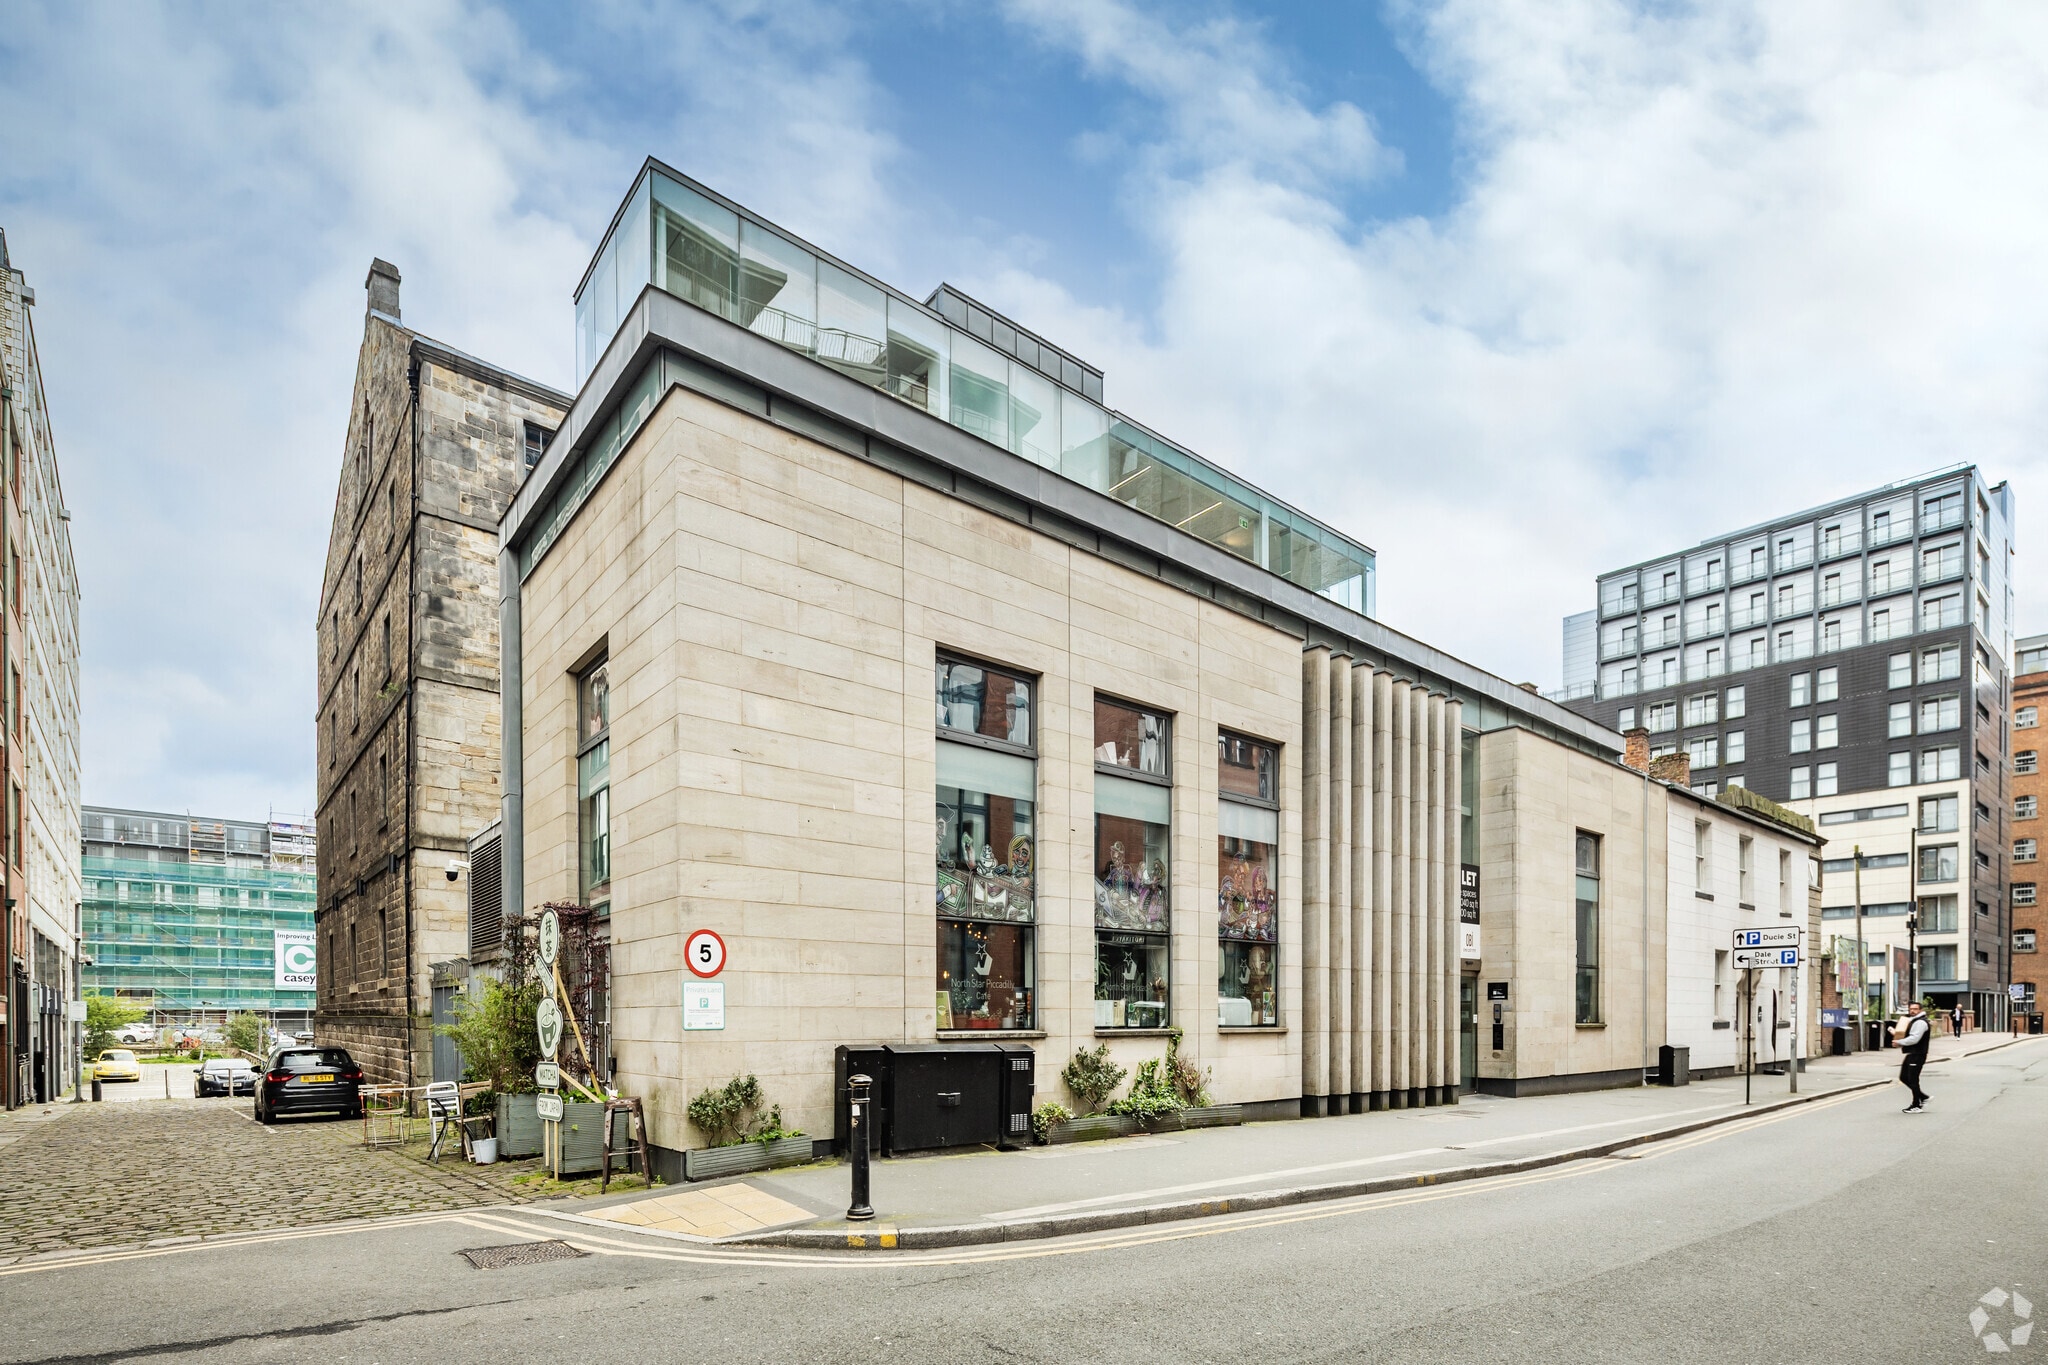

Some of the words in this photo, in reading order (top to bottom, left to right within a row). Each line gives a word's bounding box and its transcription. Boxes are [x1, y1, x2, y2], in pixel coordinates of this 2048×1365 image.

[1461, 870, 1477, 887] LET
[277, 933, 311, 941] Improving
[1749, 933, 1759, 944] P
[700, 944, 712, 963] 5
[1784, 952, 1794, 963] P
[284, 975, 316, 985] casey
[951, 978, 971, 988] North
[971, 978, 985, 988] Star
[986, 978, 1016, 991] Piccadilly
[540, 1068, 556, 1081] MATCHA
